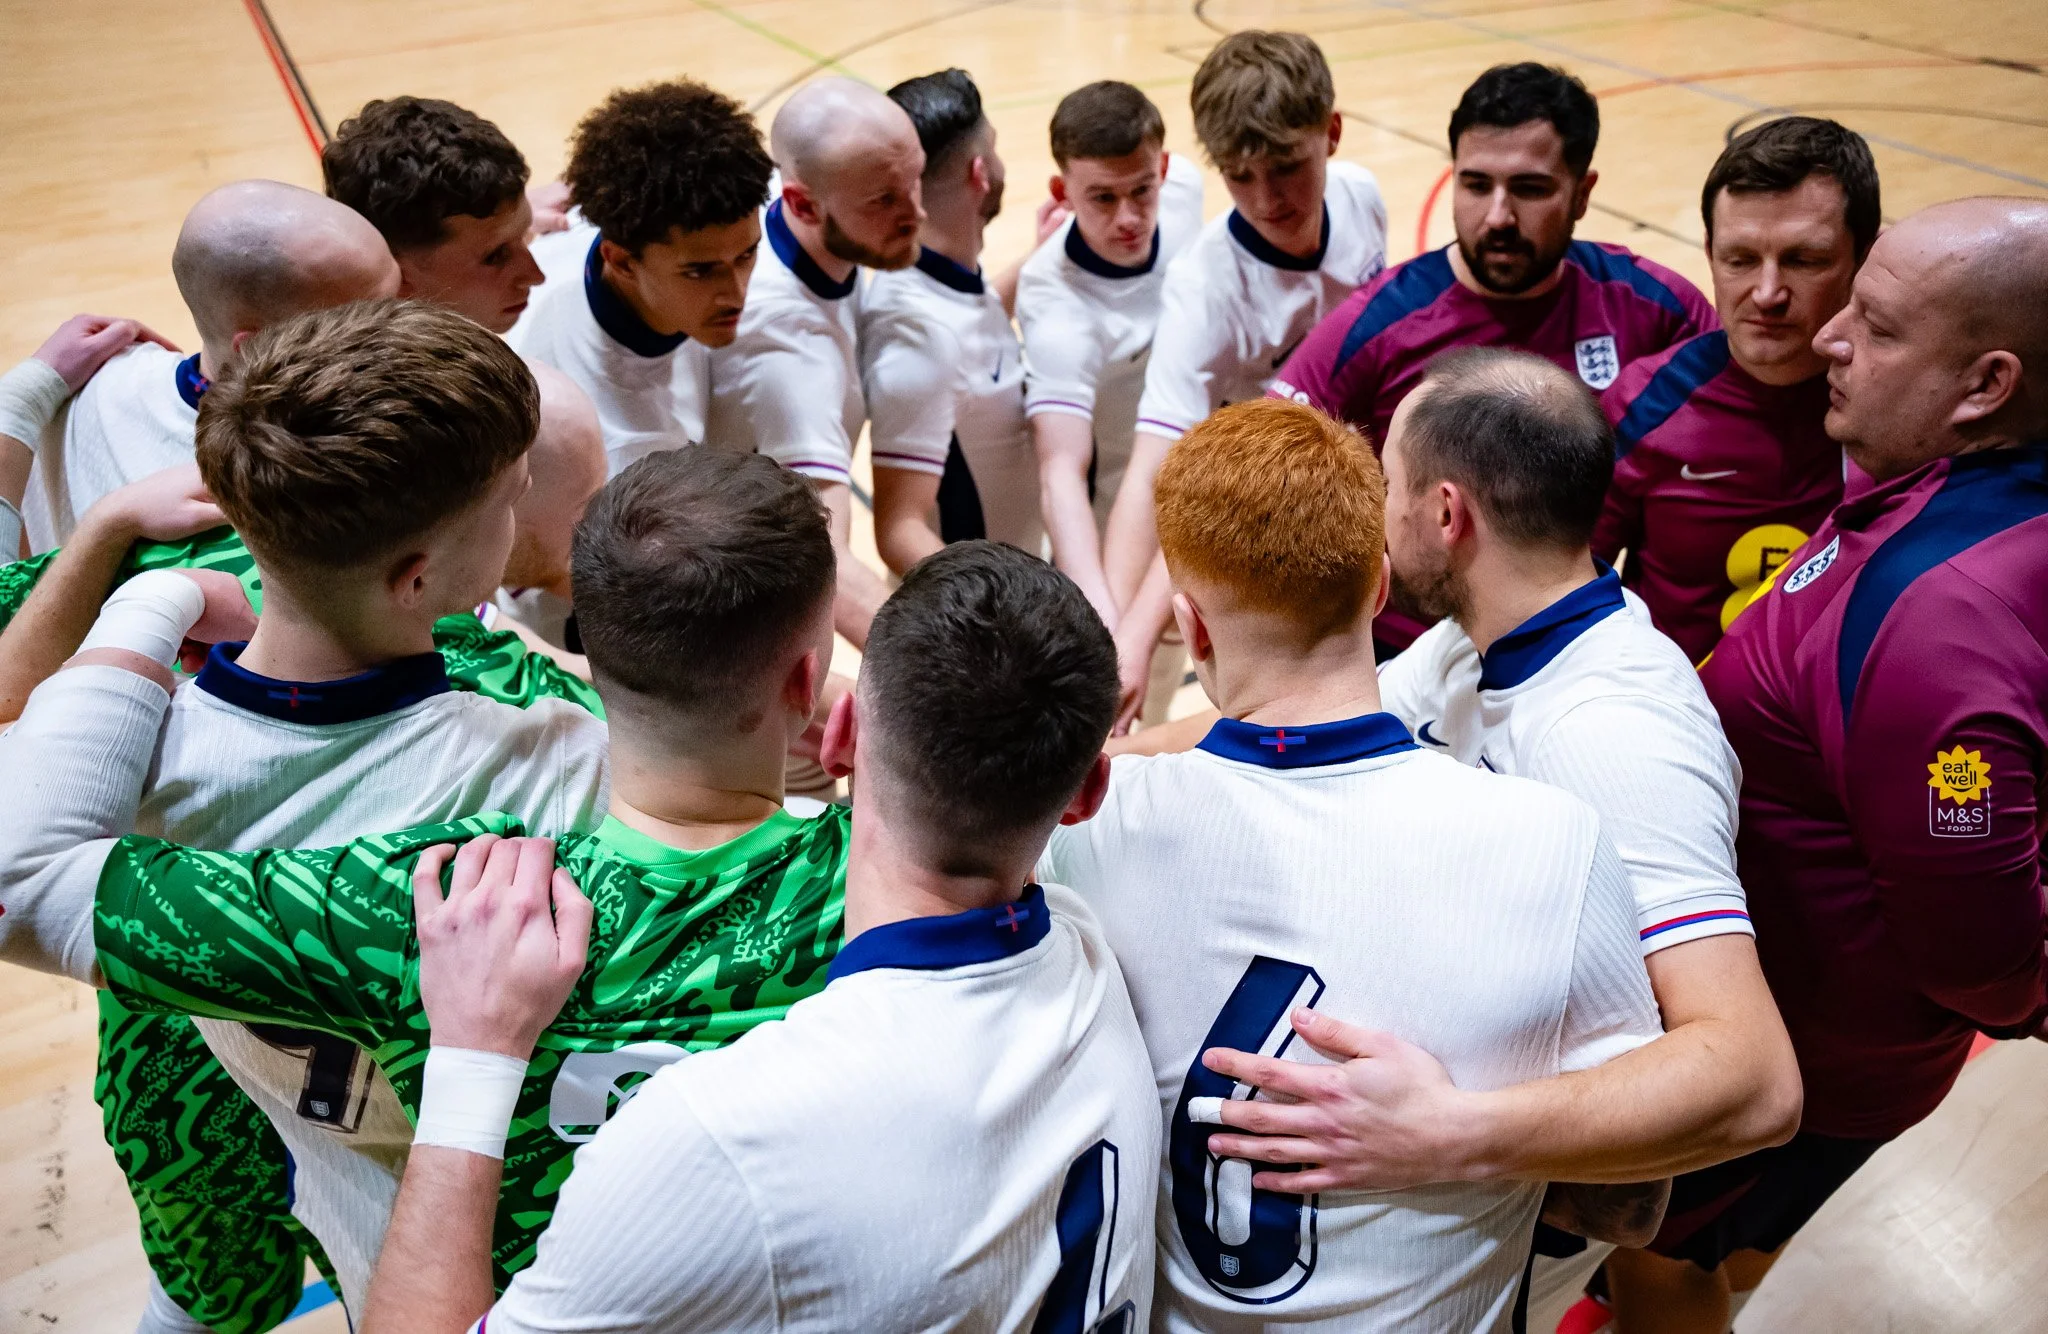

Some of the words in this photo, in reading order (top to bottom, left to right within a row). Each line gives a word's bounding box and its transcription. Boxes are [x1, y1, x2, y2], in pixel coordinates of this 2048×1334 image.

[1942, 760, 1971, 773] eat
[1943, 770, 1977, 785] well
[1937, 807, 1984, 823] M&S
[1169, 954, 1326, 1305] 6
